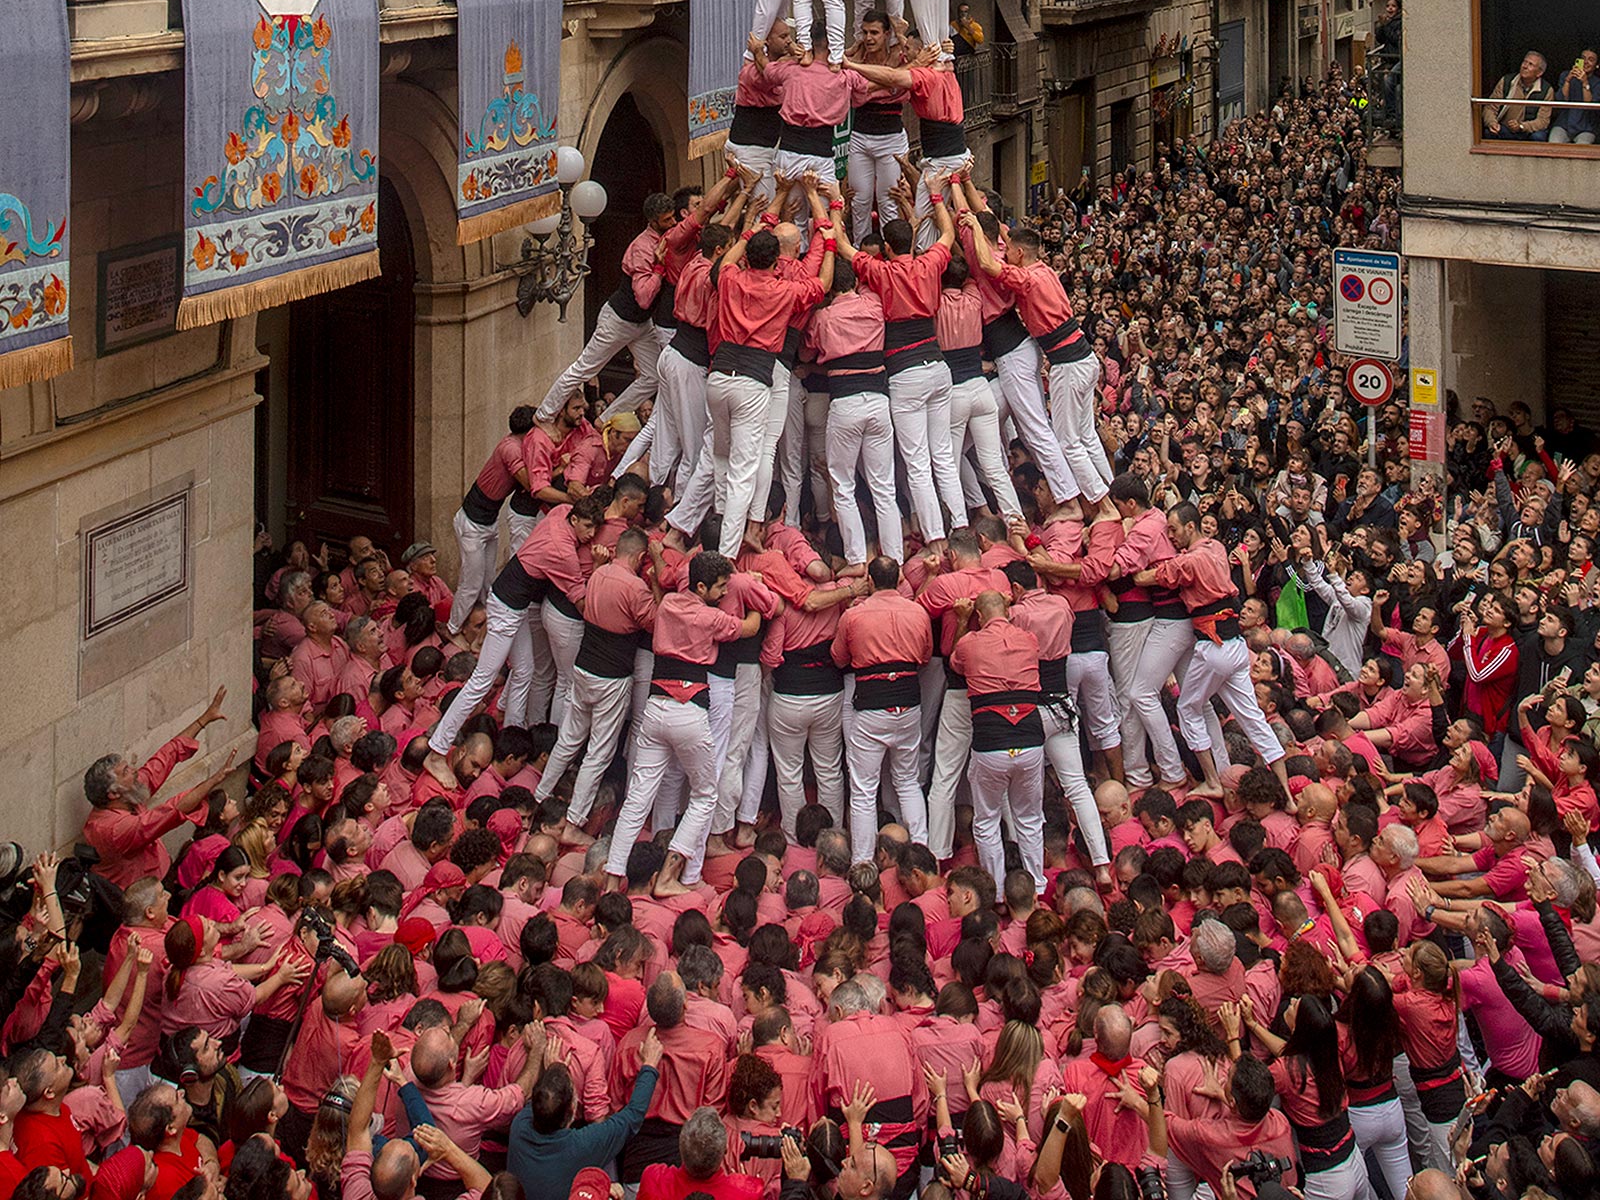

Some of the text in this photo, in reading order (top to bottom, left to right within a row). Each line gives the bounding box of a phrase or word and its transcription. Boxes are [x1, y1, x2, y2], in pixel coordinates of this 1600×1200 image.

[1346, 256, 1373, 264] Ajuntament
[1365, 268, 1393, 277] VIANANTS
[1358, 374, 1381, 390] 20
